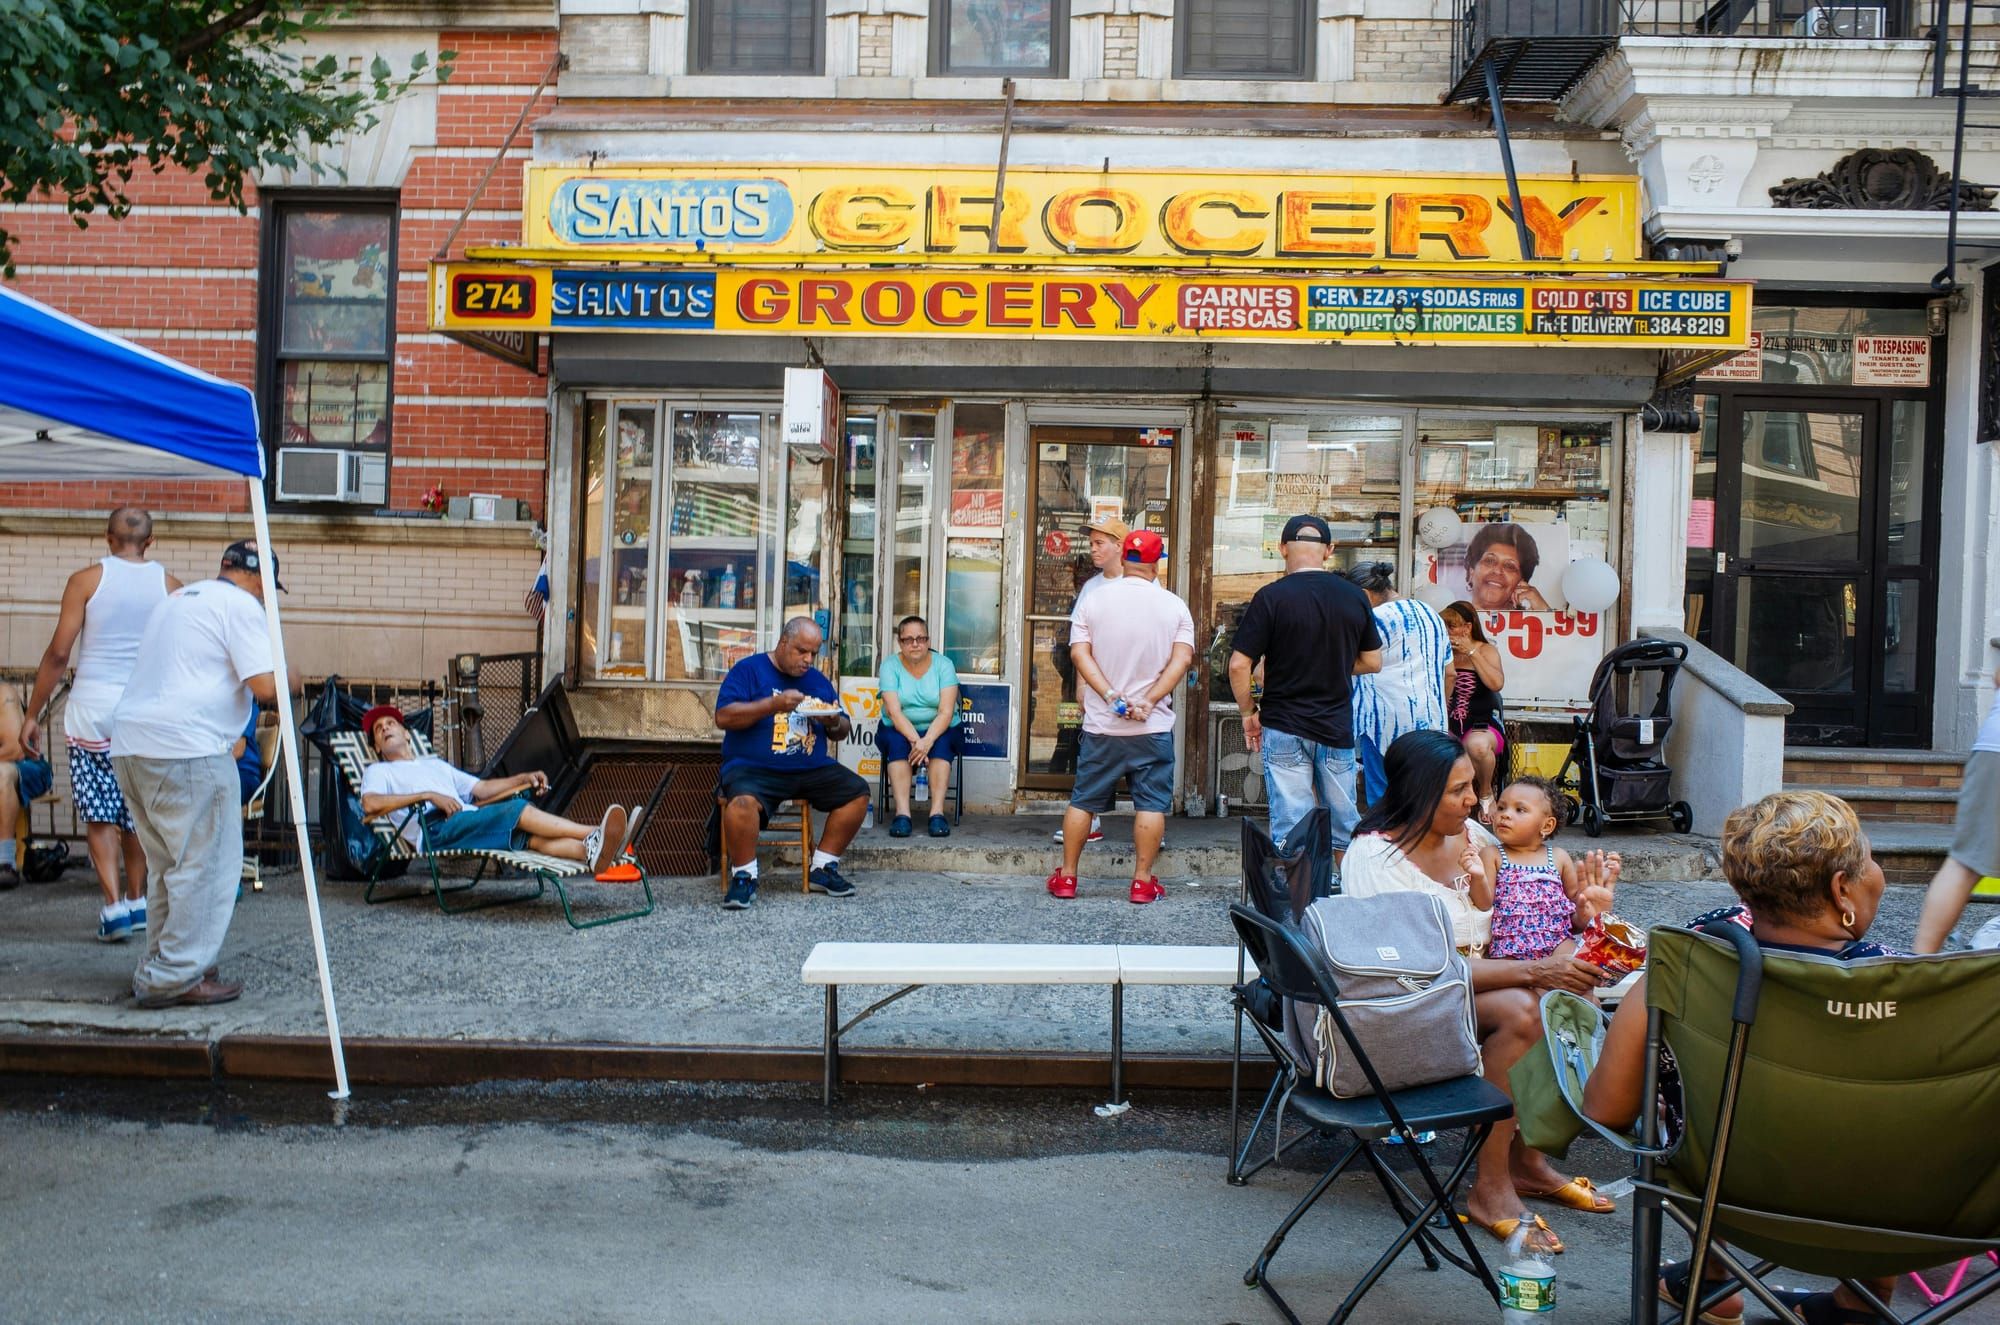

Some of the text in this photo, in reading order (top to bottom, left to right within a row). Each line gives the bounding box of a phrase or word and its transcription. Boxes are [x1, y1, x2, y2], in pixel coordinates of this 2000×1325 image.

[573, 183, 1606, 260] SANTOS GROCERY
[466, 283, 522, 310] 274
[551, 281, 713, 317] SANTOS
[737, 279, 1161, 329] GROCERY
[1185, 287, 1292, 307] CARNES
[1422, 289, 1480, 306] SODAS
[1483, 293, 1517, 307] FRIAS
[1538, 291, 1578, 308] COLD
[1644, 292, 1725, 310] ICE CUBE
[1185, 307, 1292, 328] FRESCAS
[1315, 312, 1516, 331] PRODUCTOS TROPICALES
[1573, 316, 1634, 334] DELIVERY
[1650, 317, 1725, 335] 384-8219
[1764, 337, 1779, 350] 274
[1786, 338, 1815, 351] SOUTH
[1820, 339, 1837, 352] 2ND
[1841, 339, 1853, 352] ST
[1858, 339, 1926, 354] NO TRESPASSING
[1236, 431, 1255, 441] WIC
[1266, 473, 1328, 484] GOVERNMENT
[971, 493, 985, 508] NO
[954, 508, 1001, 524] SMOKING
[1827, 1000, 1897, 1019] ULINE
